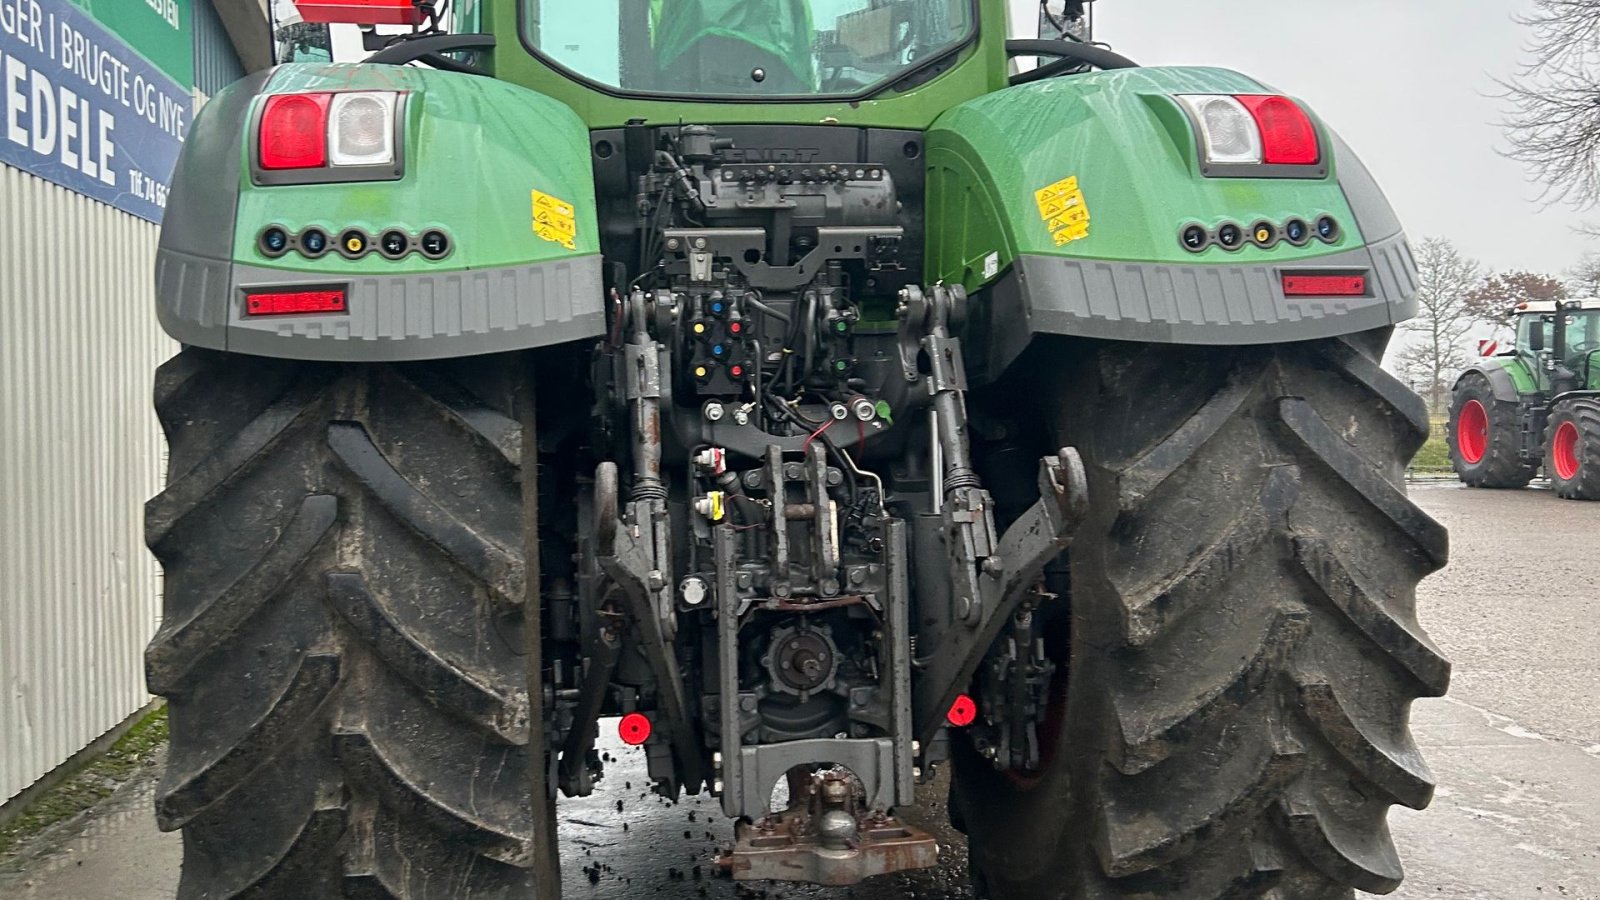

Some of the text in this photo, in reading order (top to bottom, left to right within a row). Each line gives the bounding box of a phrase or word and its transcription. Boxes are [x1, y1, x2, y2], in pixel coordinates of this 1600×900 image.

[49, 13, 55, 59] I
[61, 21, 130, 107] BRUGTE
[133, 75, 156, 124] OG
[159, 91, 185, 143] NYE
[144, 176, 155, 204] 74
